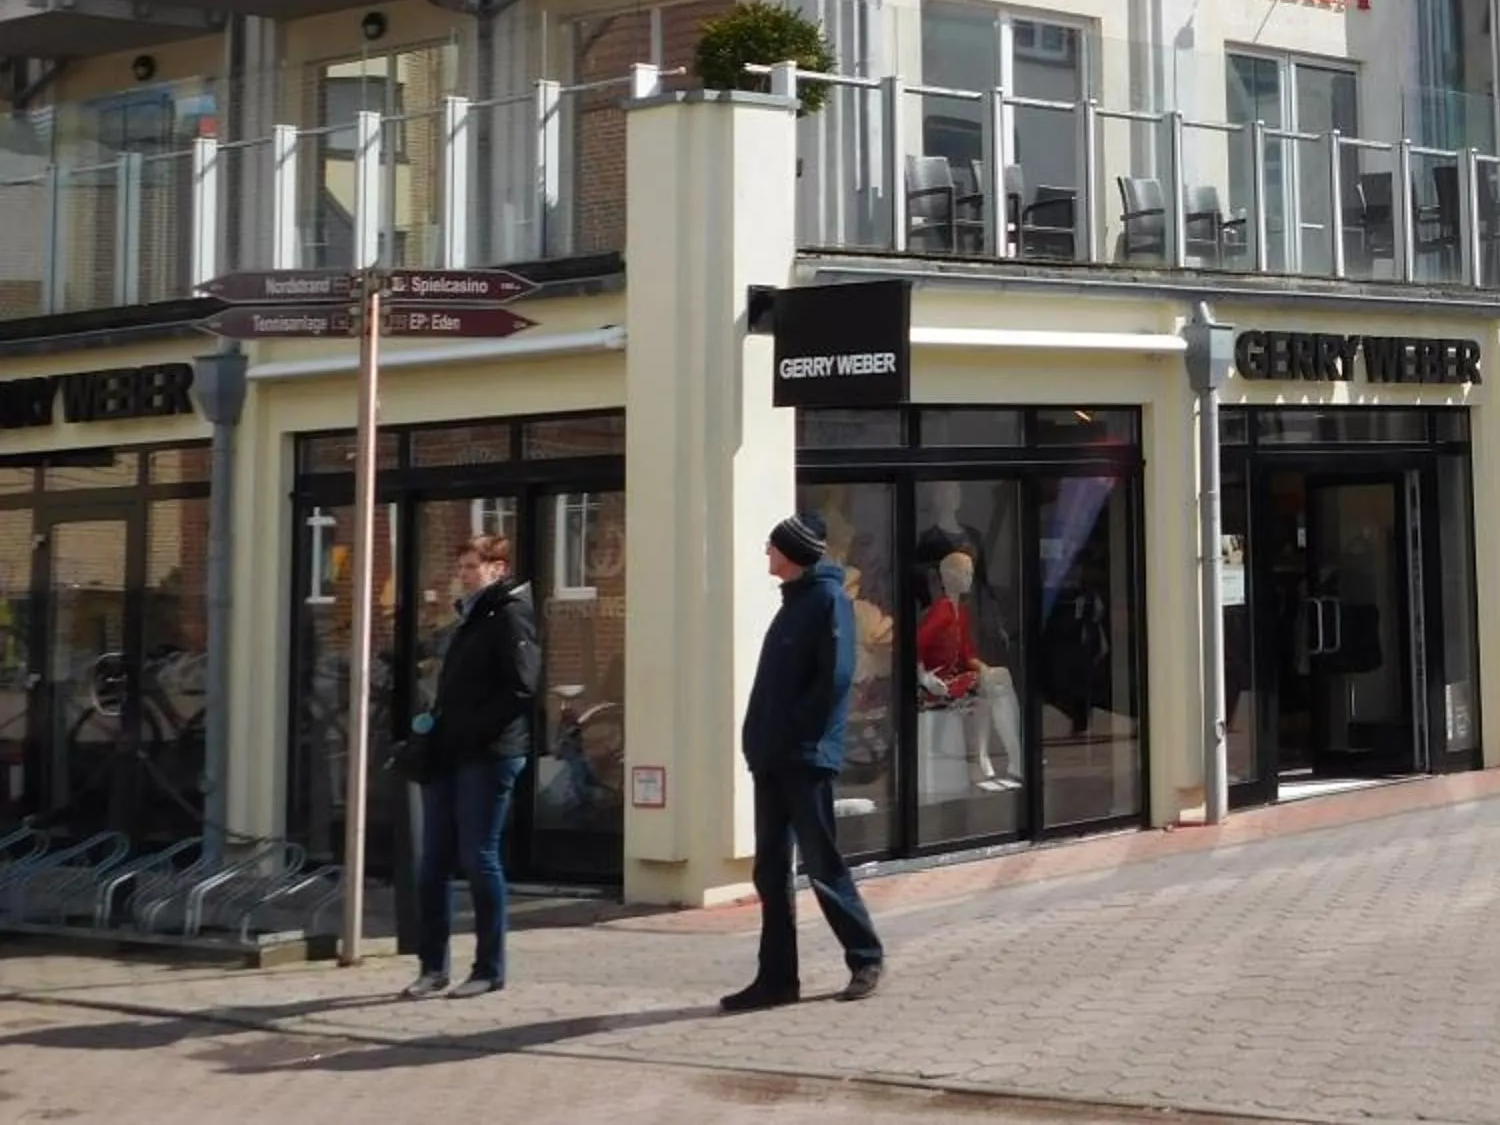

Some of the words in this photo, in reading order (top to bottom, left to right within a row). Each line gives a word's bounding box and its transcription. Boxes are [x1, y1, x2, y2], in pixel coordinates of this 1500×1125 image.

[410, 275, 489, 296] Spielcasino
[431, 313, 461, 330] Eden
[780, 355, 836, 379] GERRY
[836, 352, 896, 376] WEBER
[1234, 330, 1364, 382] GERRY
[1362, 335, 1483, 384] WEBER
[62, 362, 195, 423] WEBER
